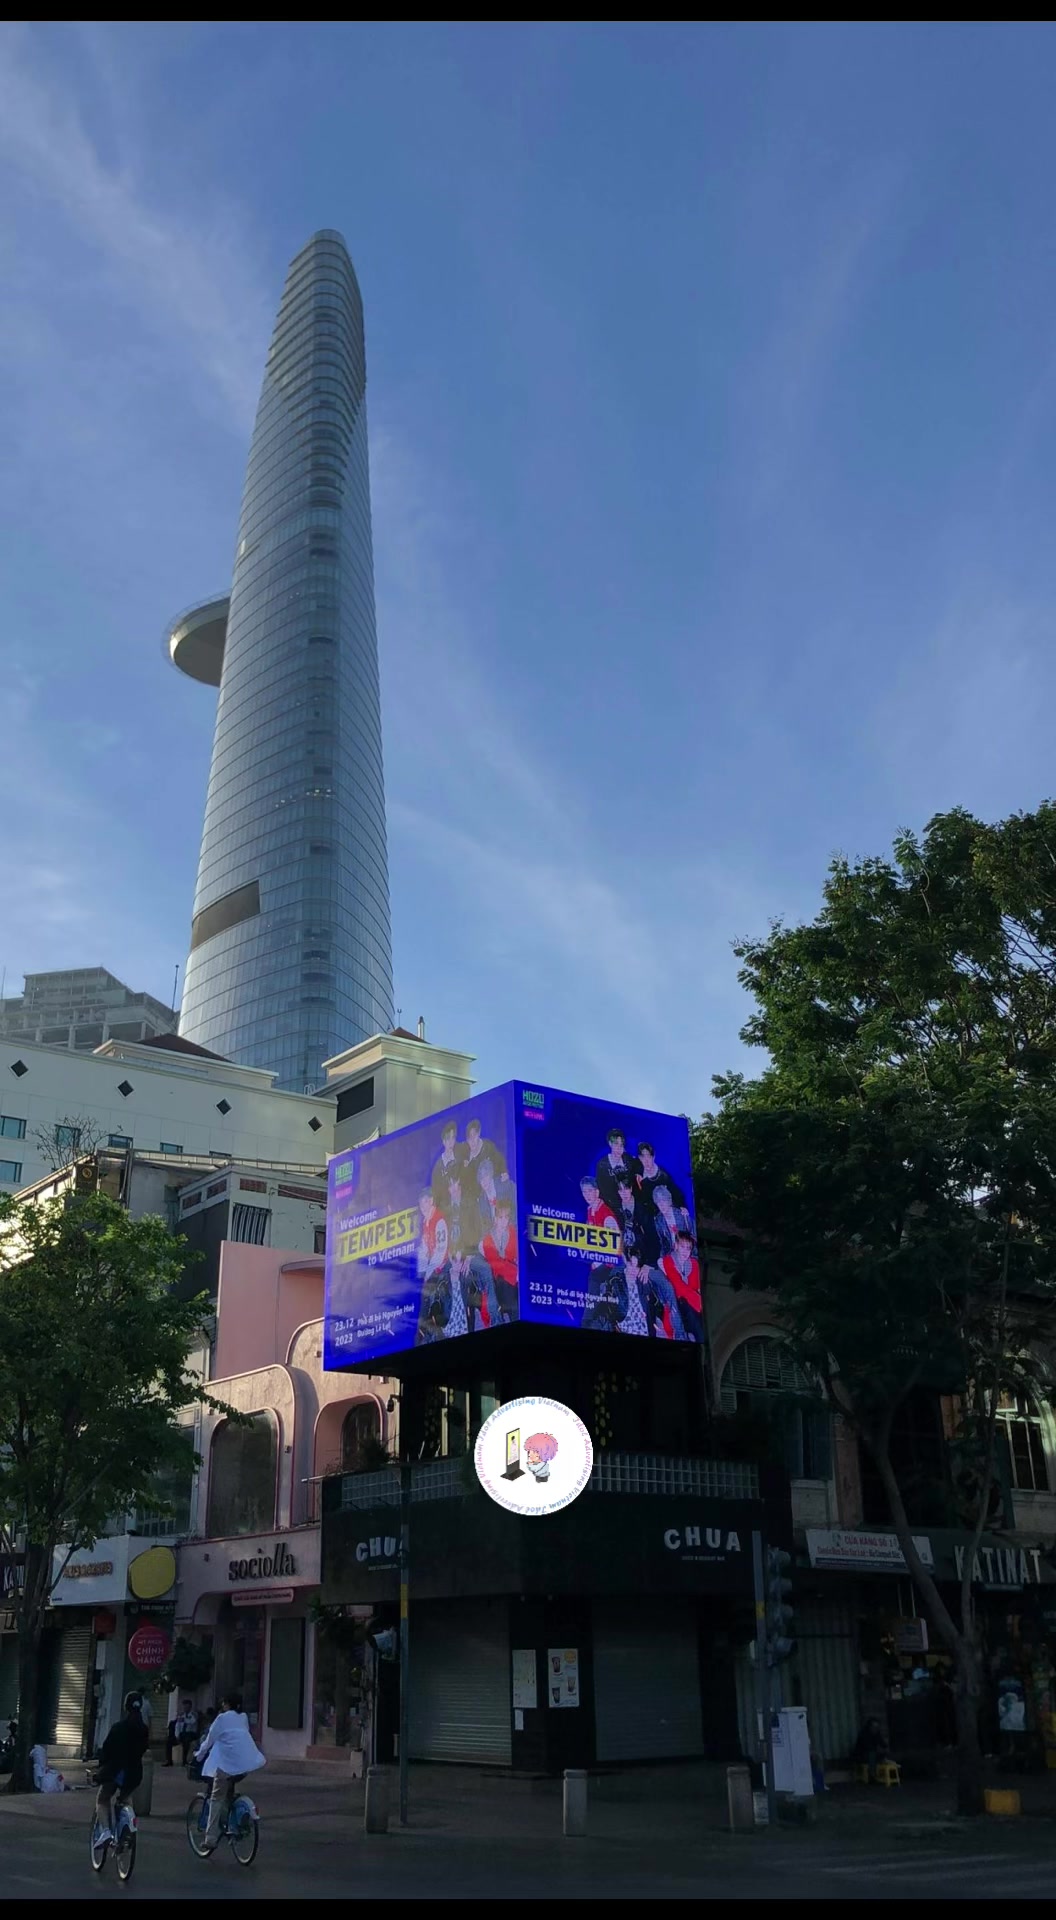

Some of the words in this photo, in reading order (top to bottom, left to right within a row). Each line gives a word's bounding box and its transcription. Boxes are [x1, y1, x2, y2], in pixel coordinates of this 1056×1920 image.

[339, 1209, 378, 1231] Welcome
[532, 1204, 576, 1221] Welcome
[338, 1210, 417, 1256] TEMPEST
[530, 1218, 620, 1250] TEMPEST
[367, 1254, 377, 1267] to
[378, 1242, 415, 1264] Vietnam
[567, 1247, 578, 1258] to
[580, 1249, 619, 1265] Vietnam
[529, 1282, 553, 1294] 23.12
[531, 1295, 553, 1305] 2023
[335, 1318, 354, 1332] 23.12
[335, 1333, 353, 1347] 2023
[663, 1526, 741, 1552] CHUA
[228, 1543, 296, 1581] sociolla
